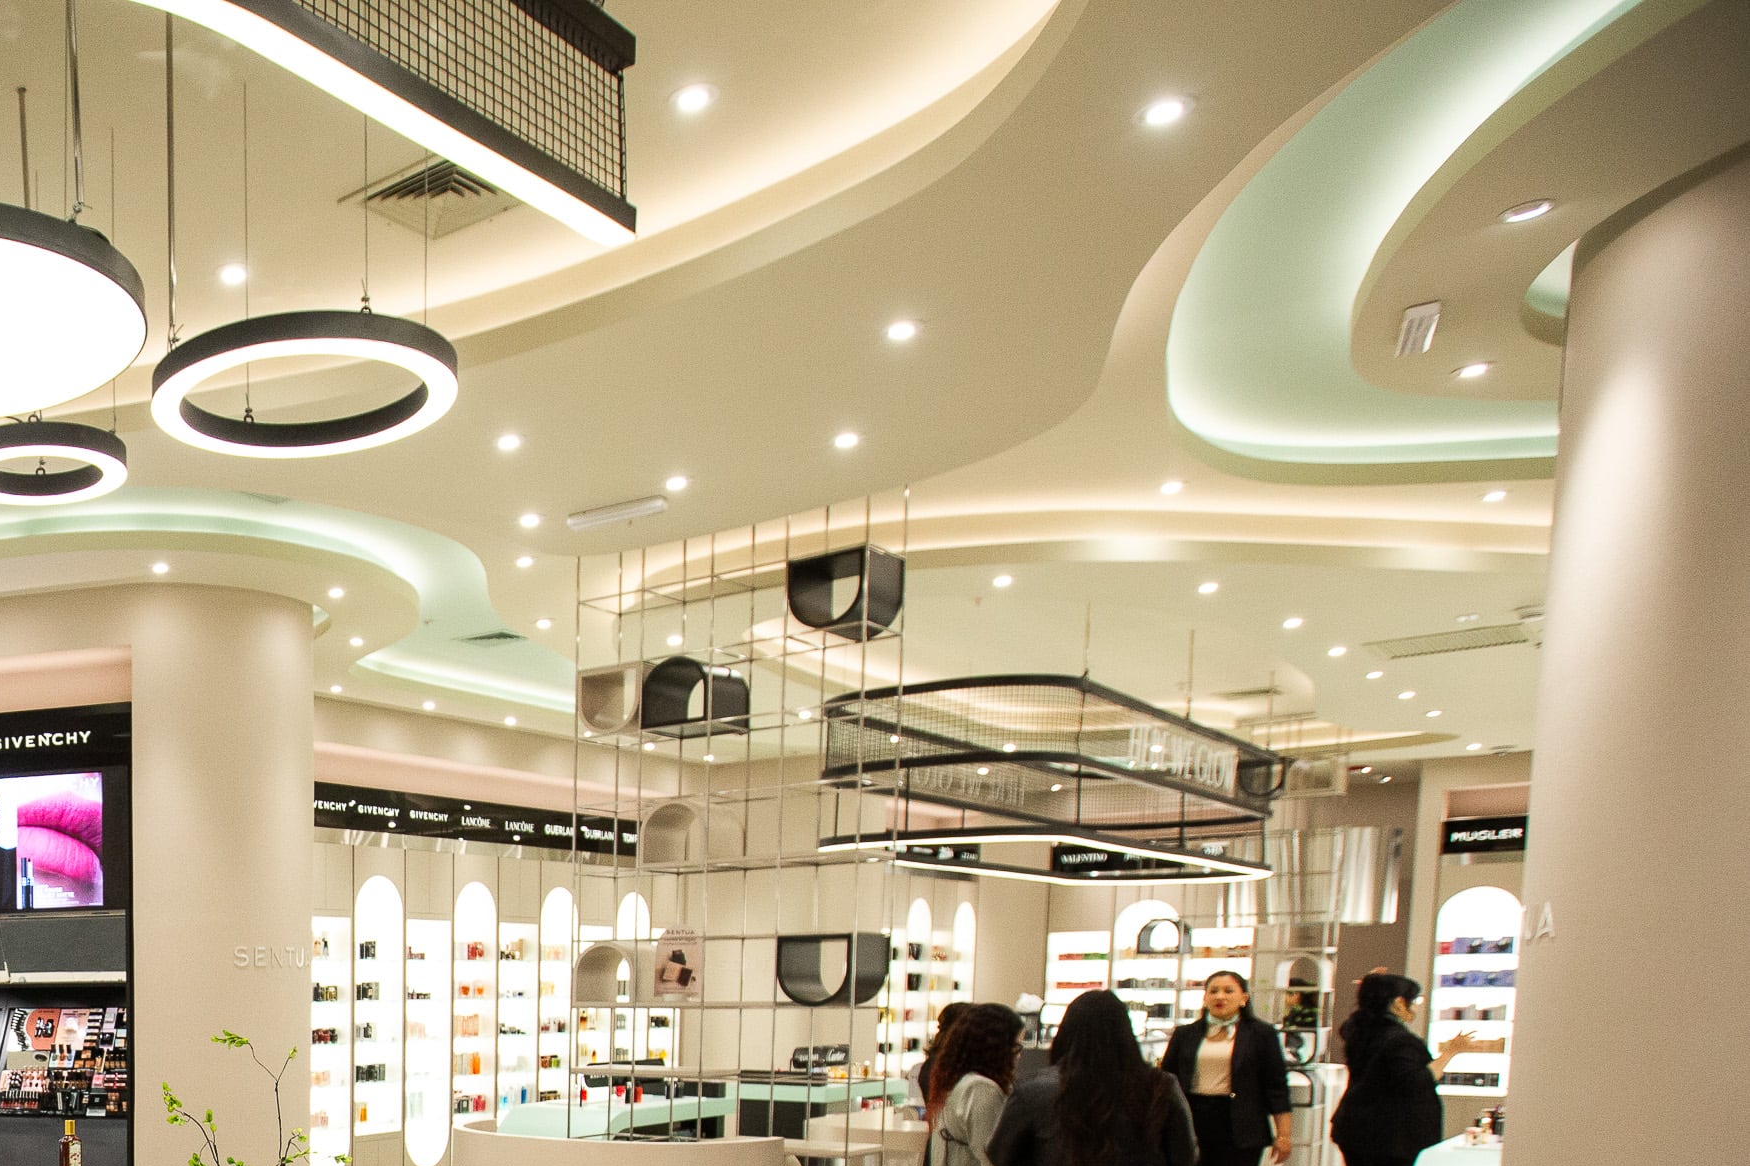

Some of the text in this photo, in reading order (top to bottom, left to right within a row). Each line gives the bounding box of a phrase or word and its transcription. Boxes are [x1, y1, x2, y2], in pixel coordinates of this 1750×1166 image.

[314, 799, 347, 812] VENCHY
[357, 804, 400, 817] GIVENCHY
[409, 809, 449, 822] GIVENCHY
[544, 823, 574, 837] GUERLAI
[1450, 828, 1524, 843] MUGLER
[1061, 852, 1108, 865] VALENTINO
